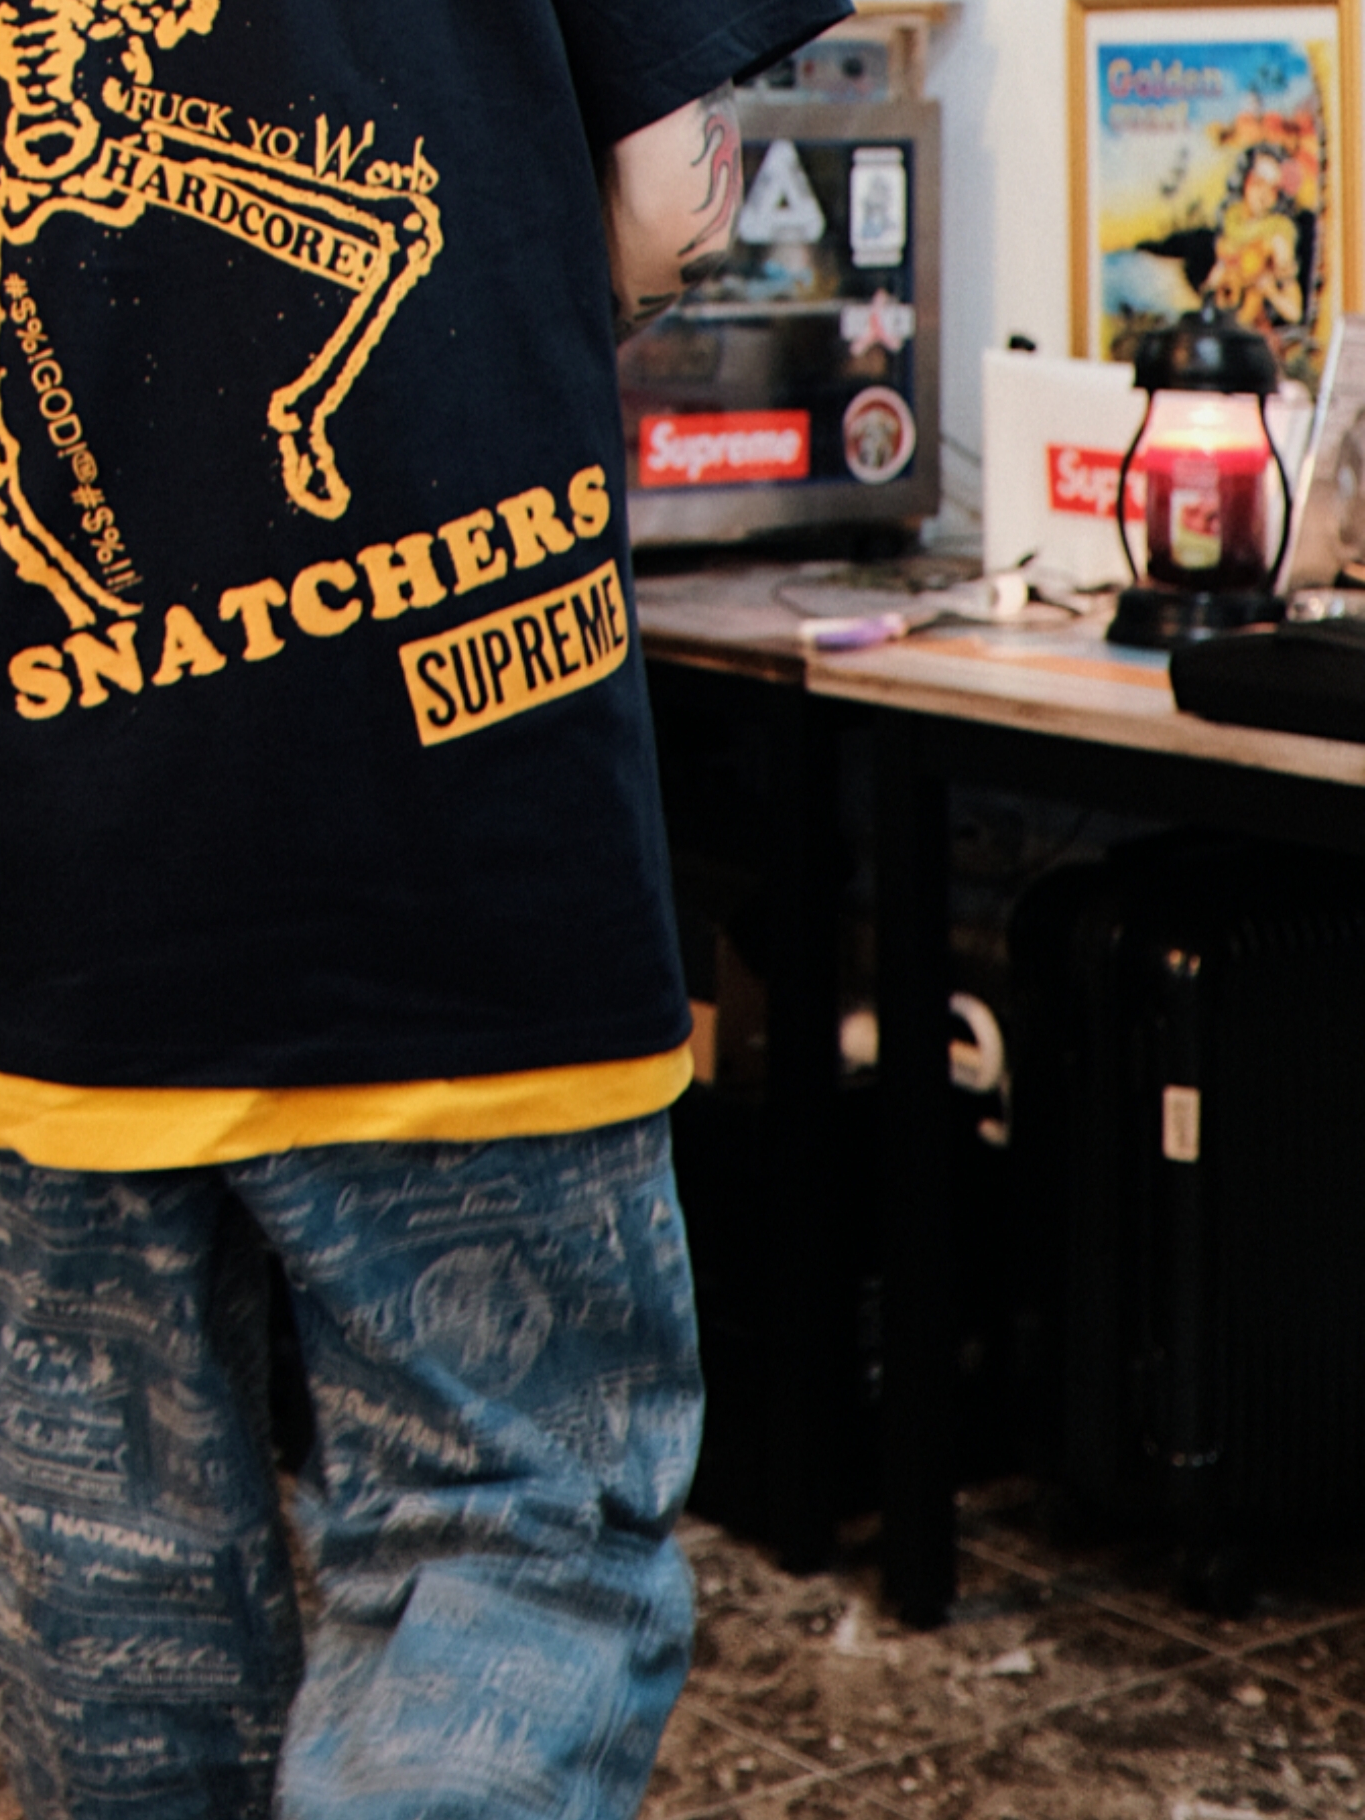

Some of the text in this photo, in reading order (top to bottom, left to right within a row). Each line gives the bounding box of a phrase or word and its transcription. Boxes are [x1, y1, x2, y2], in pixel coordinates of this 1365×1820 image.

[125, 86, 233, 139] FUCK
[102, 147, 376, 285] HARDCORE!
[648, 421, 802, 482] Supreme
[8, 464, 611, 721] SNATCHERS
[417, 572, 625, 728] SUPREME
